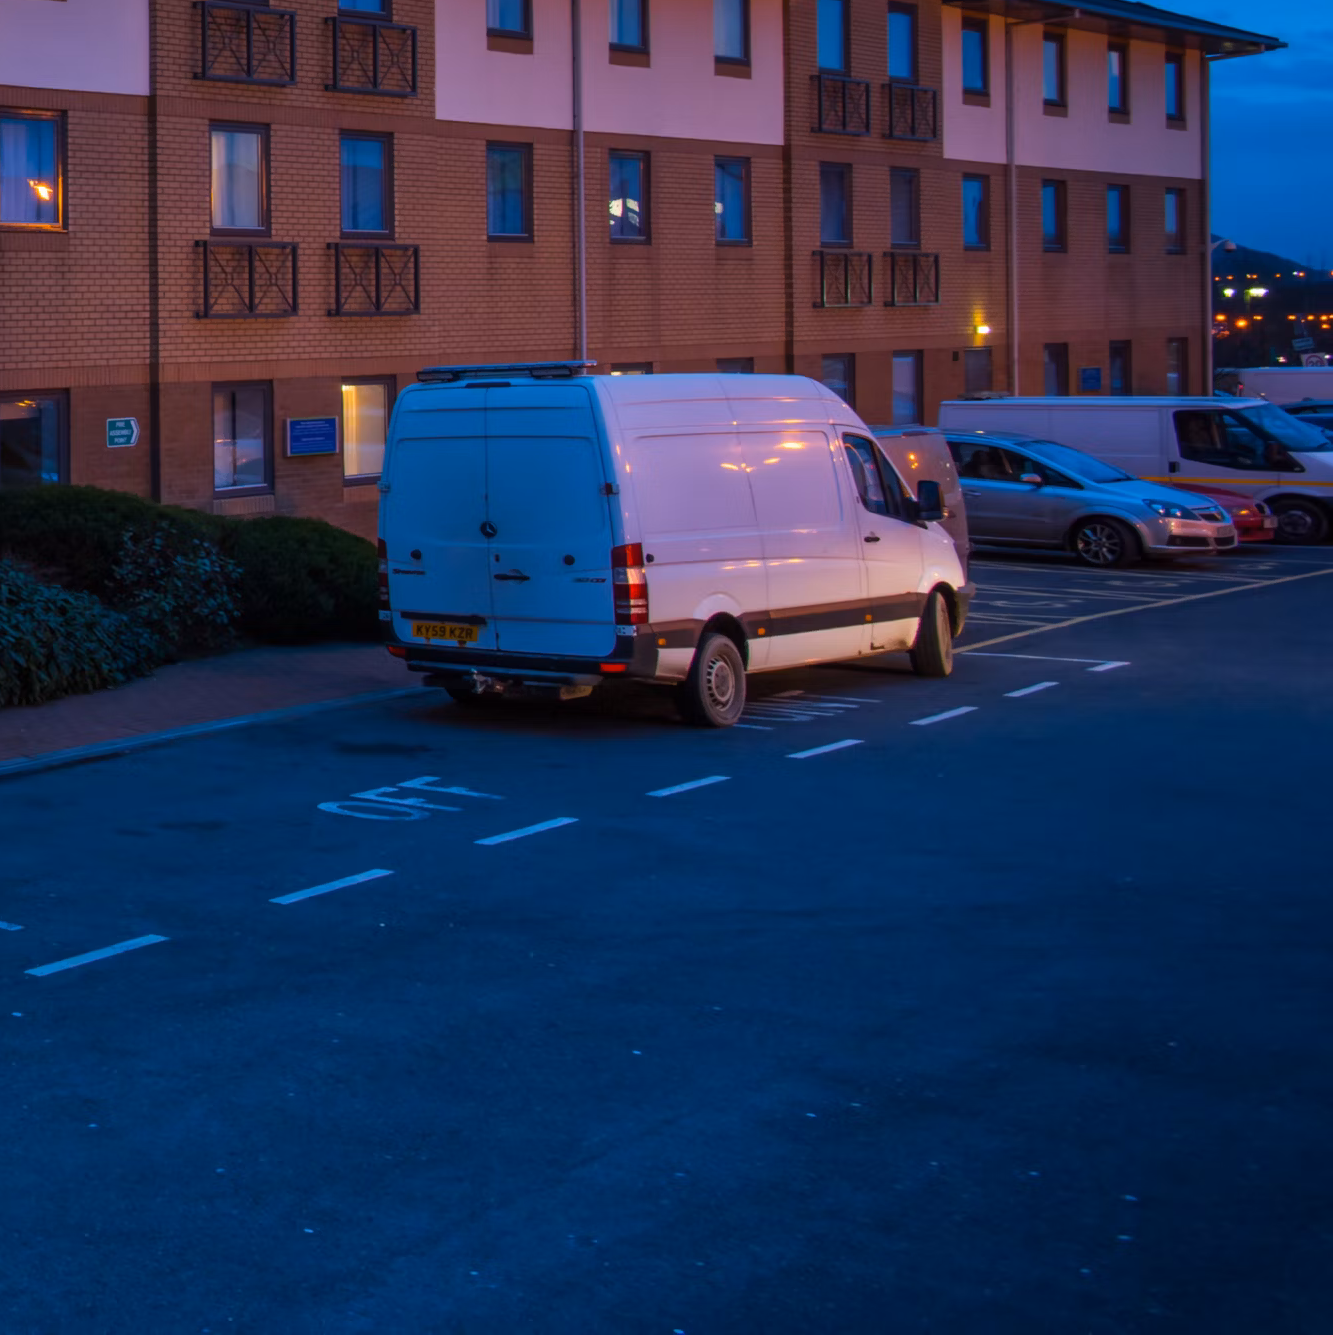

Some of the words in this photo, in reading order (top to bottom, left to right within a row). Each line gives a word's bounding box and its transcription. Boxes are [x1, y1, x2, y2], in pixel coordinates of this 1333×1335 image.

[416, 625, 446, 638] KY59
[449, 626, 474, 640] KZR
[315, 775, 507, 821] OFF
